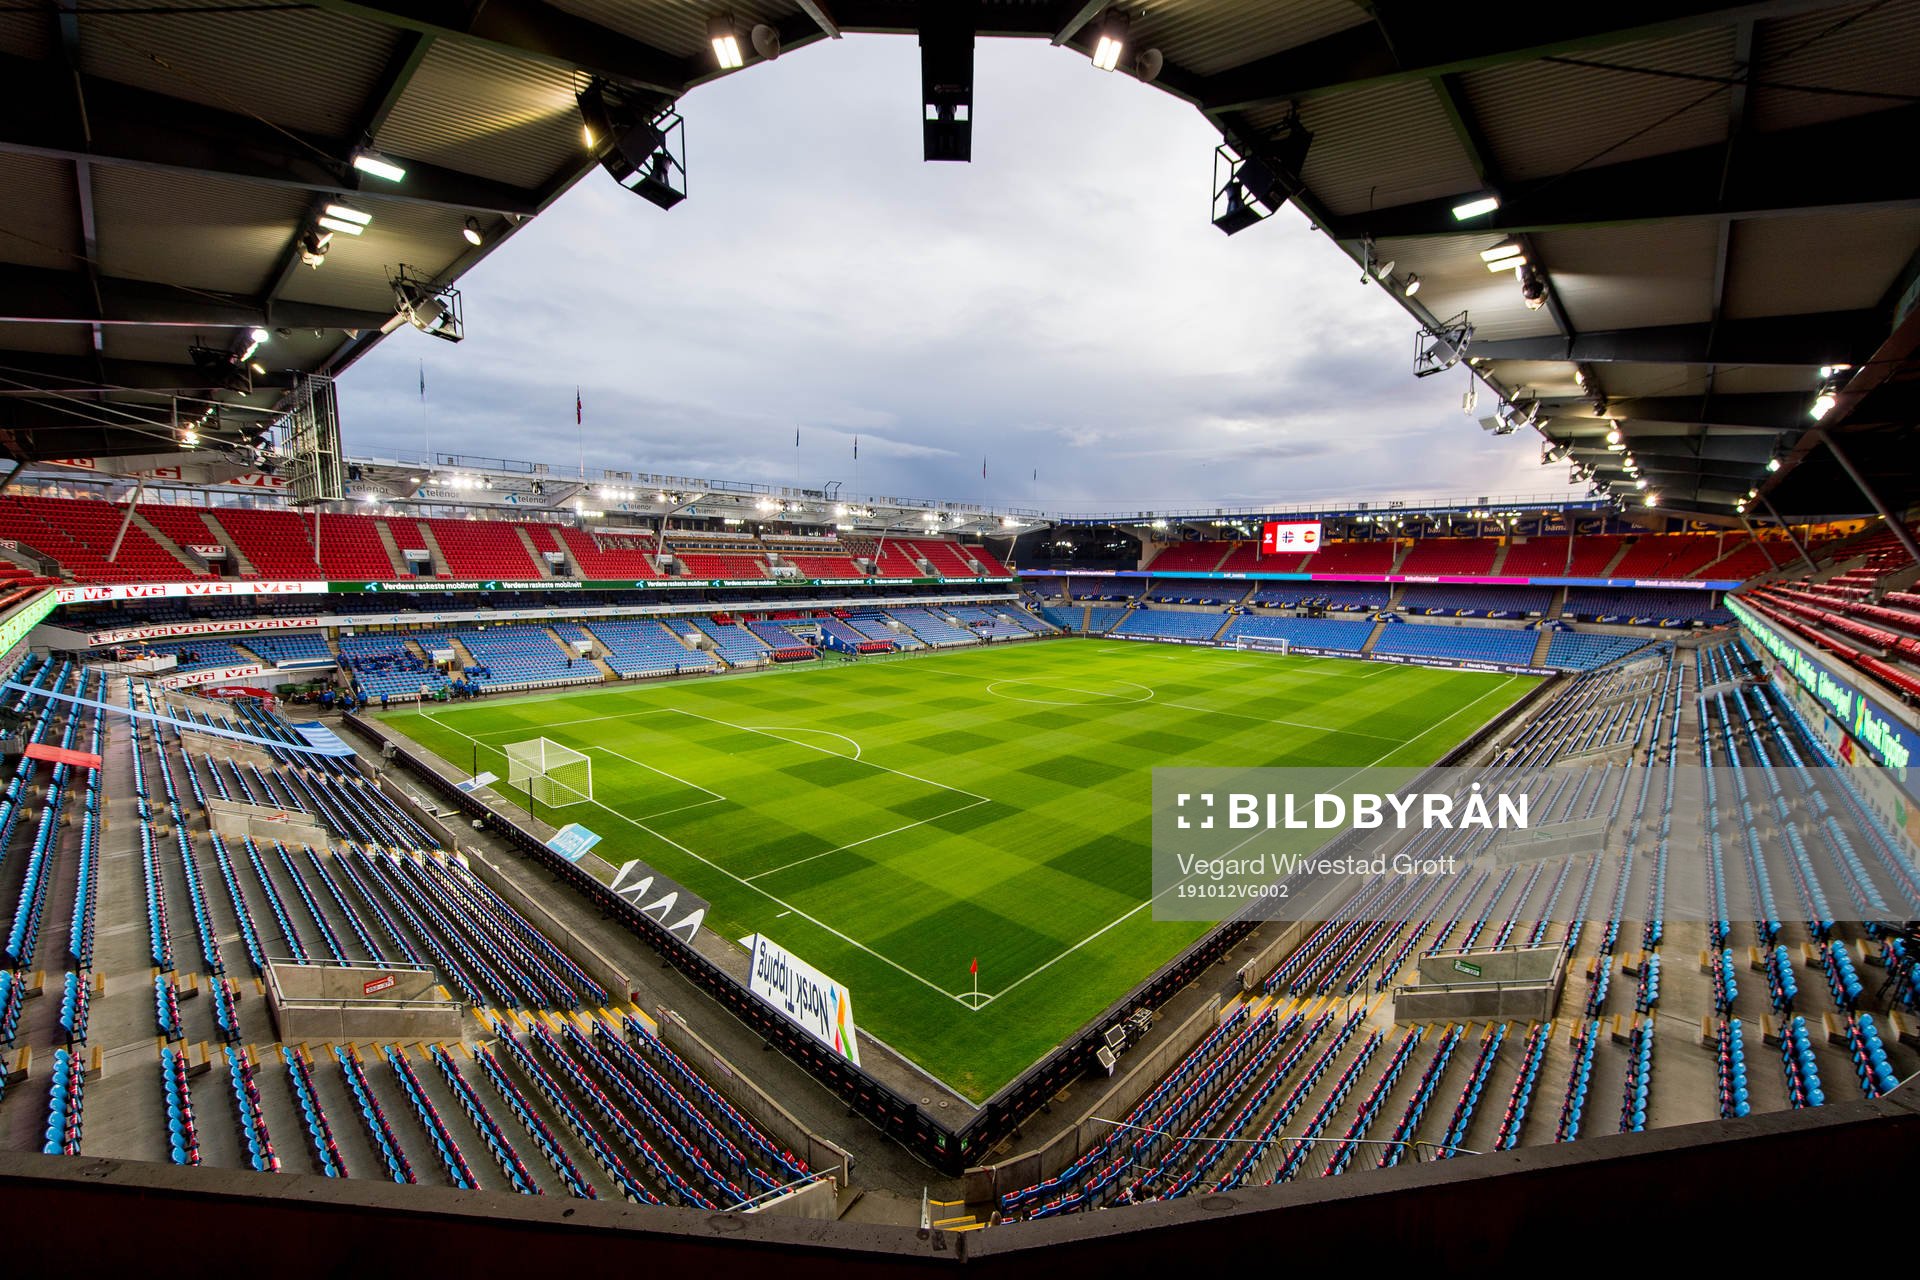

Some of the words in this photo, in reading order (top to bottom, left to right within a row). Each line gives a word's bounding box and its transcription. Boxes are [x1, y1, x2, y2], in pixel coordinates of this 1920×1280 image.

[518, 495, 547, 504] telenor
[628, 503, 652, 511] telenor
[190, 545, 226, 553] VG
[186, 585, 232, 594] VG
[254, 583, 302, 592] VG
[382, 582, 415, 590] Verdens
[415, 582, 446, 590] raskeste
[83, 587, 112, 600] VG
[126, 586, 166, 597] VG
[208, 622, 242, 632] VG
[245, 620, 279, 630] VG
[283, 618, 318, 627] VG
[140, 627, 168, 638] VG
[171, 624, 205, 635] VG
[226, 667, 259, 677] VG
[1481, 663, 1499, 671] Tipping
[187, 673, 215, 684] VG
[757, 941, 795, 1014] Tipping
[796, 973, 831, 1040] Norsk
